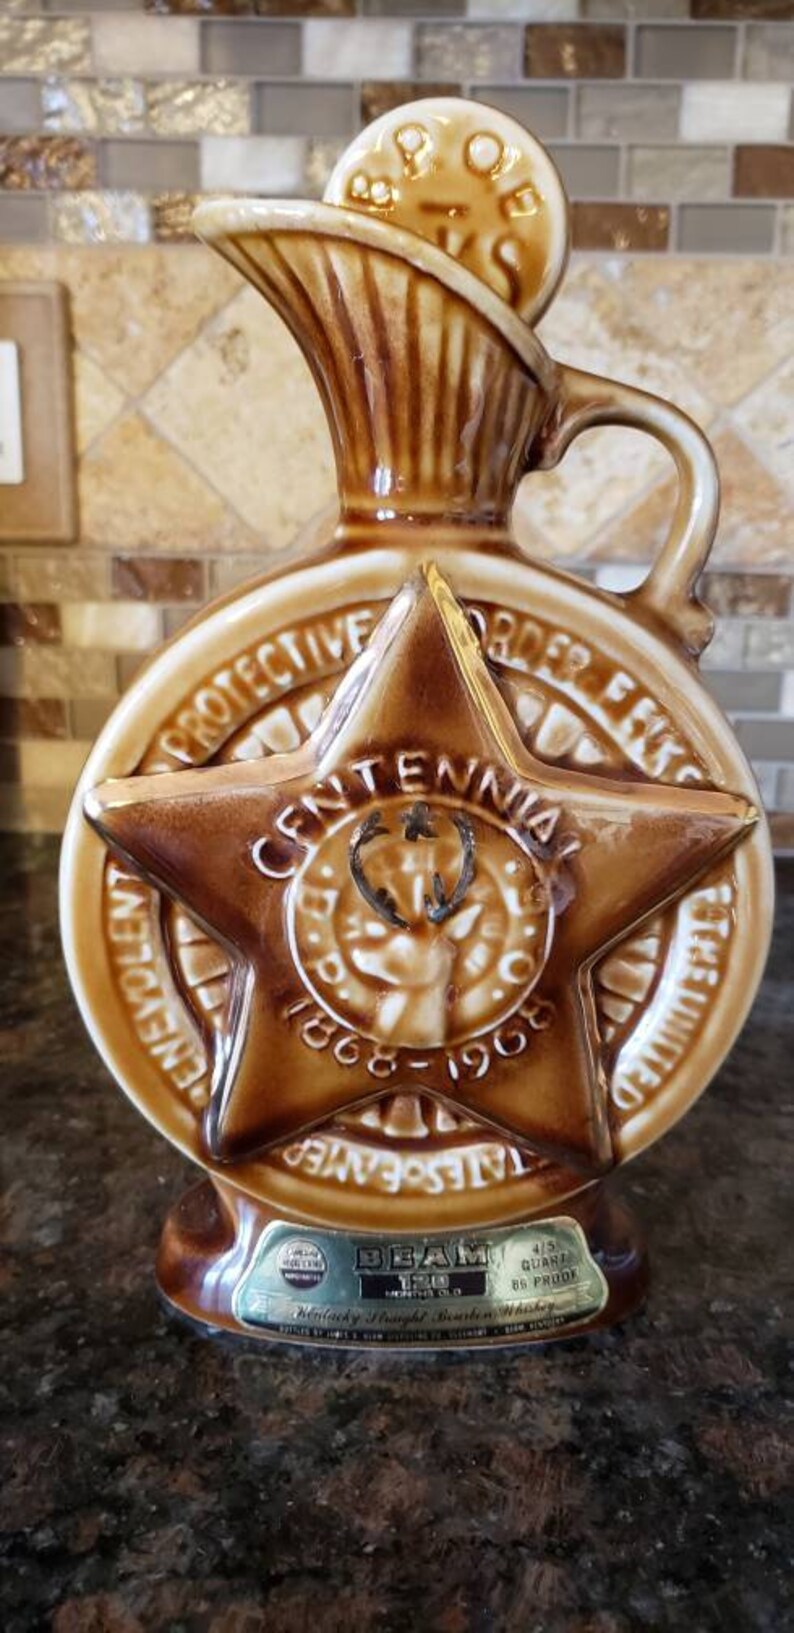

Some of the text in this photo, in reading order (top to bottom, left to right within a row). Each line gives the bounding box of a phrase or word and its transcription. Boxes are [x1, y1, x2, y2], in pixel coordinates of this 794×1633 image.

[159, 607, 376, 766] PROTECTIVE
[355, 1243, 489, 1270] BEAM
[521, 1251, 568, 1272] QUART
[398, 1272, 450, 1291] 120
[533, 1267, 578, 1289] PROOF
